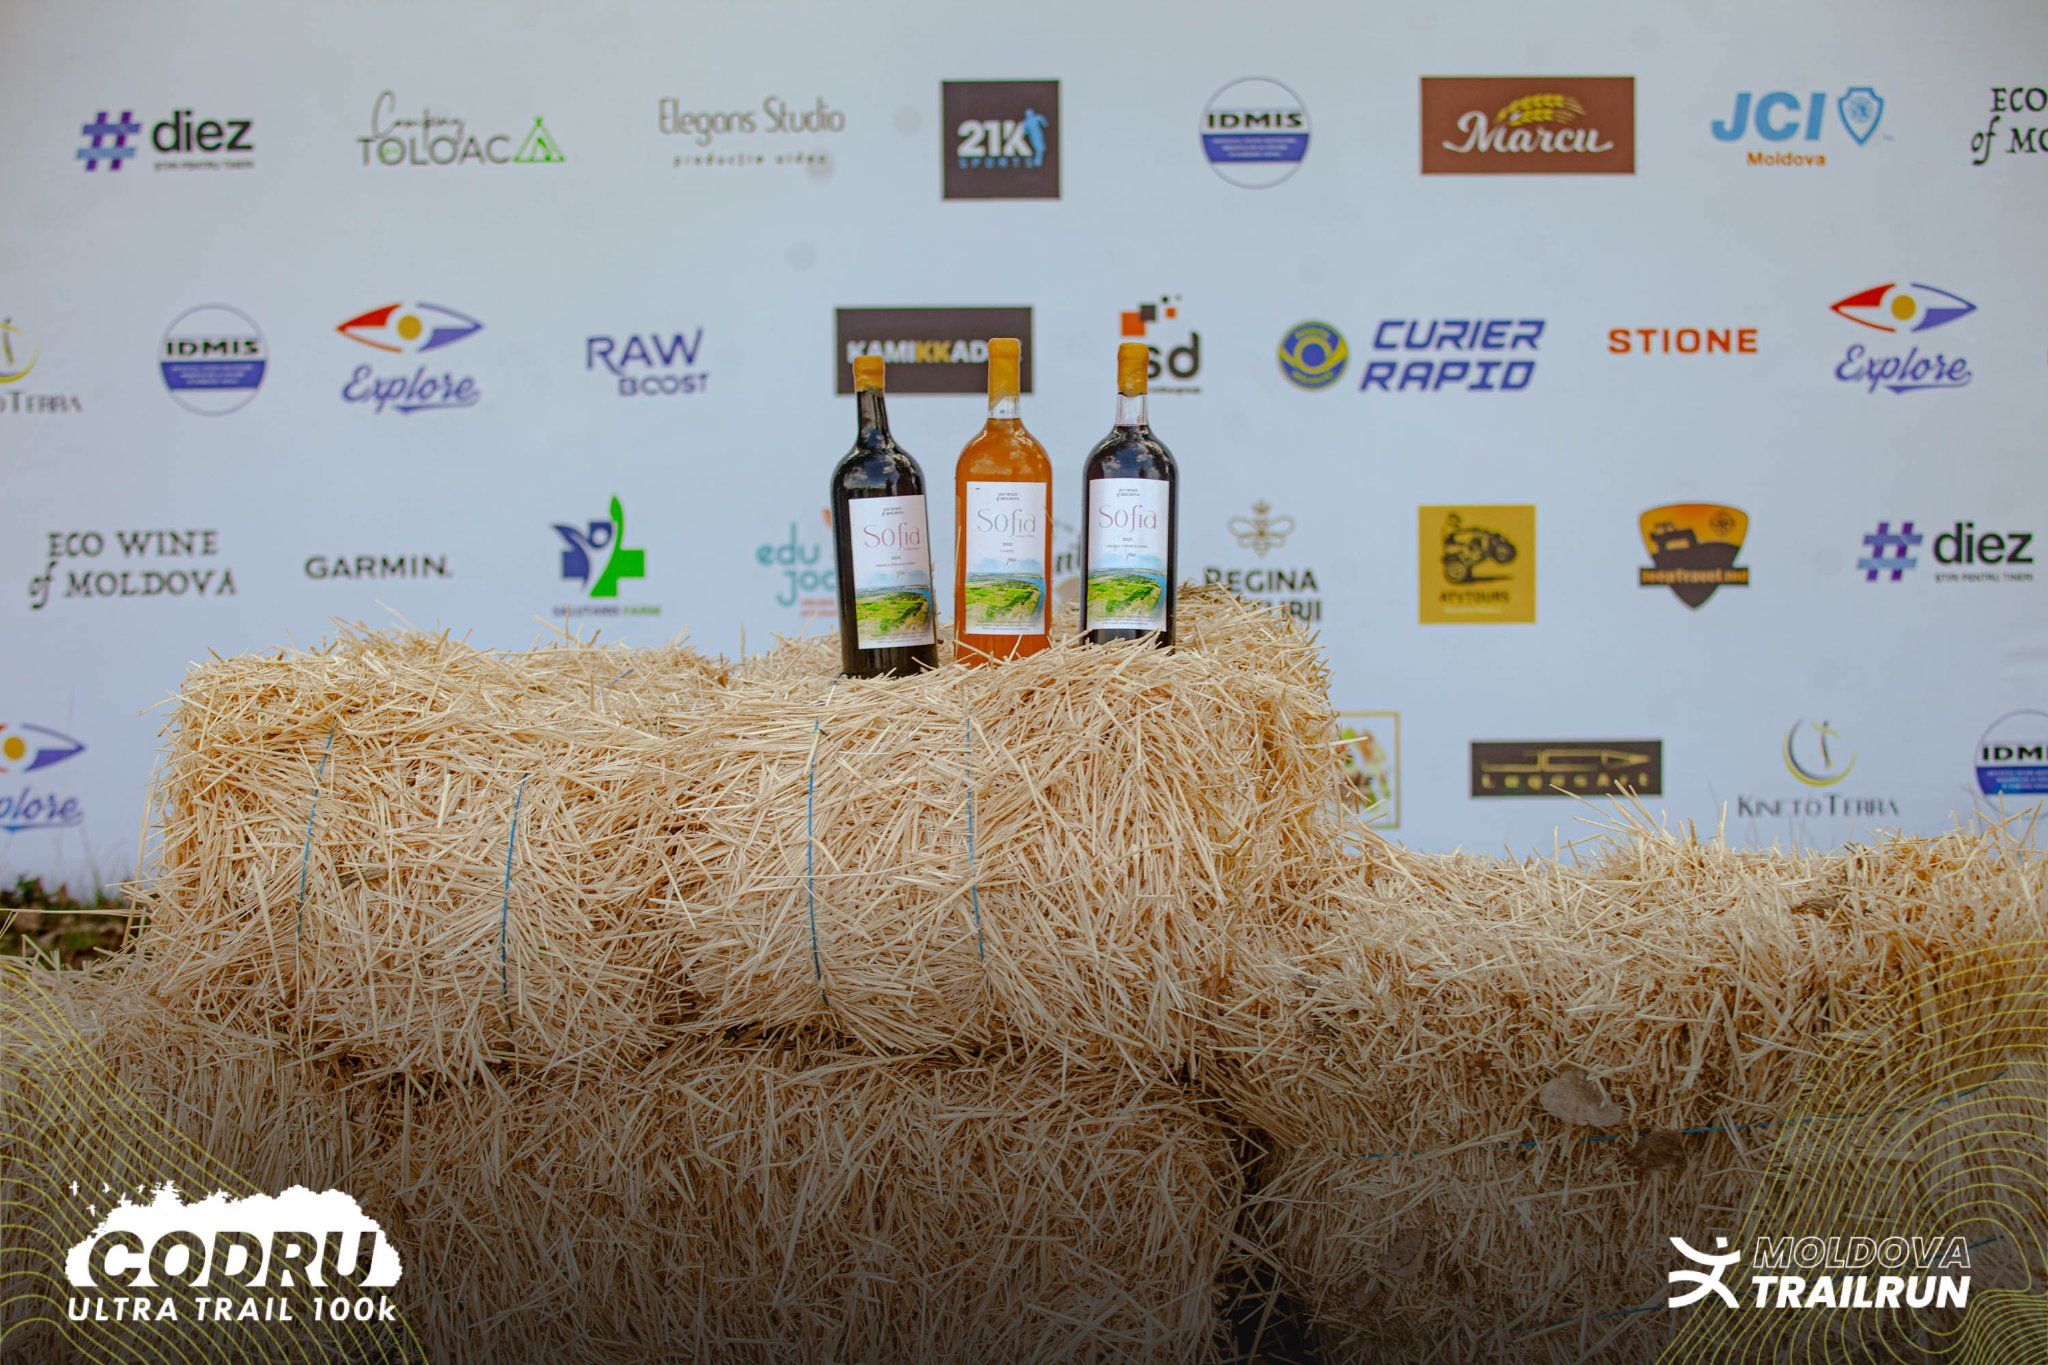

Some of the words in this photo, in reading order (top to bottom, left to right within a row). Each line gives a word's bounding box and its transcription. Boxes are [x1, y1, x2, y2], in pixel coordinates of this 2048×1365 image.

[763, 95, 846, 133] Studio
[1990, 87, 2048, 113] ECO
[1207, 112, 1303, 129] IDMIS
[1710, 91, 1827, 142] JCI
[957, 118, 1034, 157] 21K
[1441, 110, 1615, 154] Marcu
[1971, 115, 2001, 166] of
[1746, 152, 1827, 168] Moldova
[164, 338, 260, 357] IDMIS
[585, 325, 704, 375] RAW
[1371, 319, 1547, 351] CURIER
[1607, 328, 1759, 355] STIONE
[1358, 361, 1537, 392] RAPID
[1833, 343, 1976, 395] Explore
[341, 363, 482, 415] Explore
[618, 372, 709, 398] BOOST
[977, 508, 1036, 538] Sofia
[1098, 504, 1157, 534] Sofia
[47, 531, 104, 559] ECO
[117, 530, 219, 557] WINE
[755, 521, 820, 566] edu
[863, 522, 921, 551] Sofia
[28, 561, 58, 610] of
[64, 569, 238, 599] MOLDOVA
[1204, 566, 1319, 594] REGINA
[1982, 745, 2048, 762] IDM
